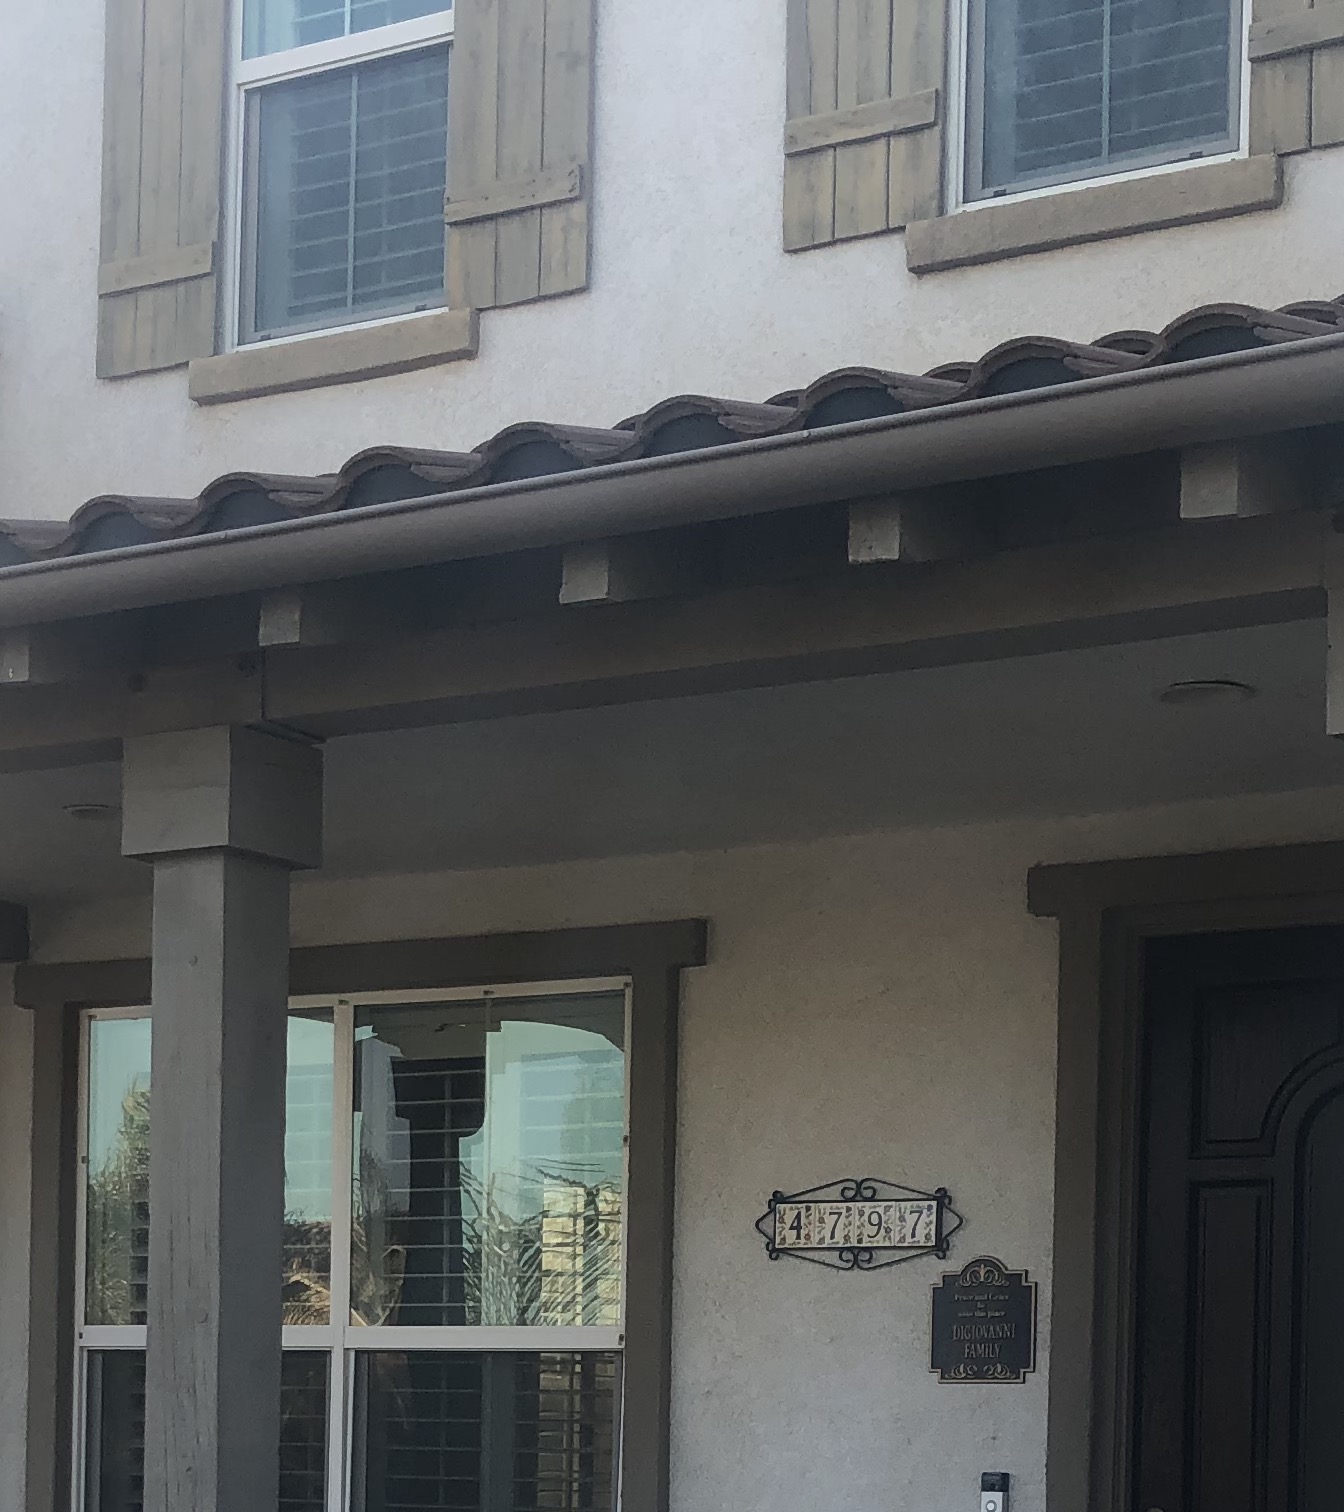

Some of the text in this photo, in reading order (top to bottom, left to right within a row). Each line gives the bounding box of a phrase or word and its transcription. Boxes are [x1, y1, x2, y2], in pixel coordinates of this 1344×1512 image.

[789, 1210, 924, 1241] 4797
[953, 1323, 1016, 1340] DIGIOVANNI
[964, 1343, 1001, 1358] FAMILY
